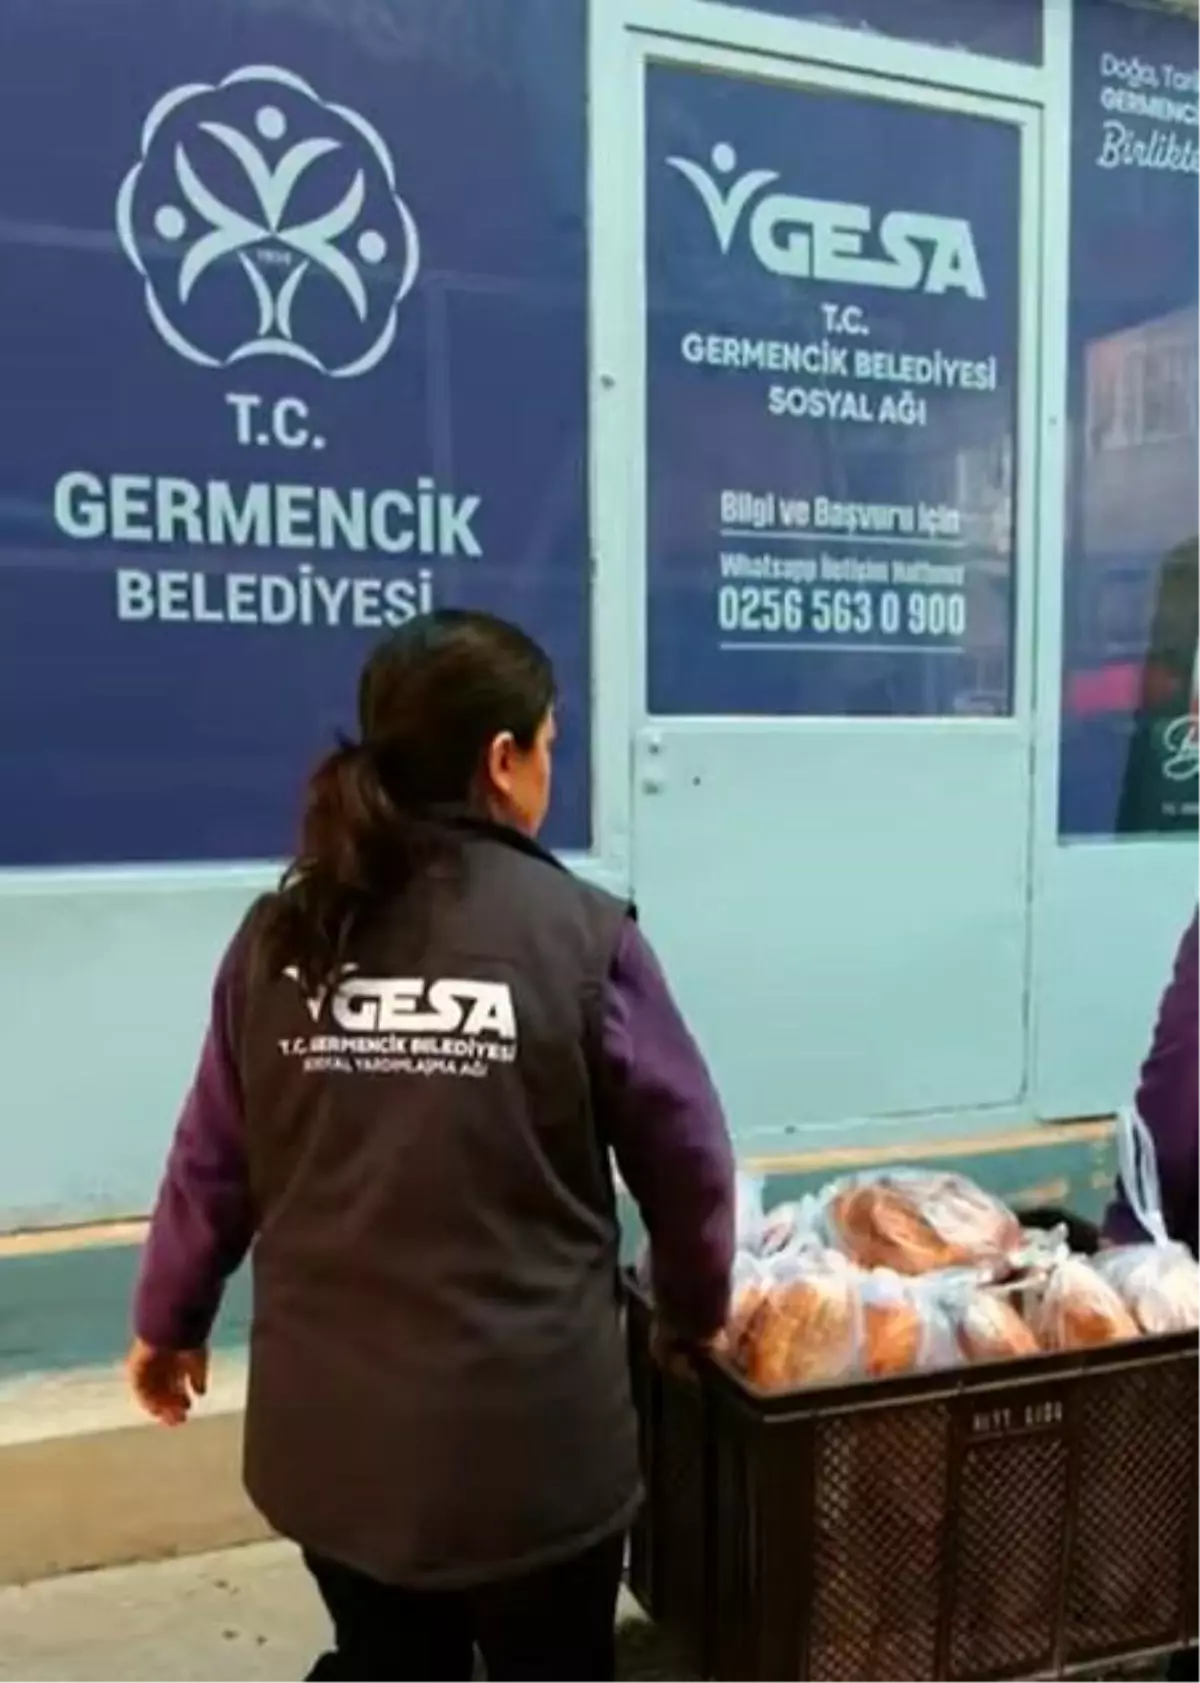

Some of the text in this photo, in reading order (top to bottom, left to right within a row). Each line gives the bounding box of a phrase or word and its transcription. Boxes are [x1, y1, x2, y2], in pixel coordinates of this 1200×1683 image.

[751, 194, 987, 300] GESA
[821, 303, 869, 336] T.C.
[681, 332, 997, 391] GERMENCİK BELEDİYESİ
[225, 392, 328, 449] T.C.
[768, 385, 927, 426] SOSYAL AĞI
[53, 470, 484, 557] GERMENCİK
[720, 488, 775, 528] Bilgi
[780, 498, 810, 526] ve
[116, 563, 433, 627] BELEDİYESİ
[719, 584, 966, 636] 0256 563 0 900
[331, 977, 517, 1039] GESA
